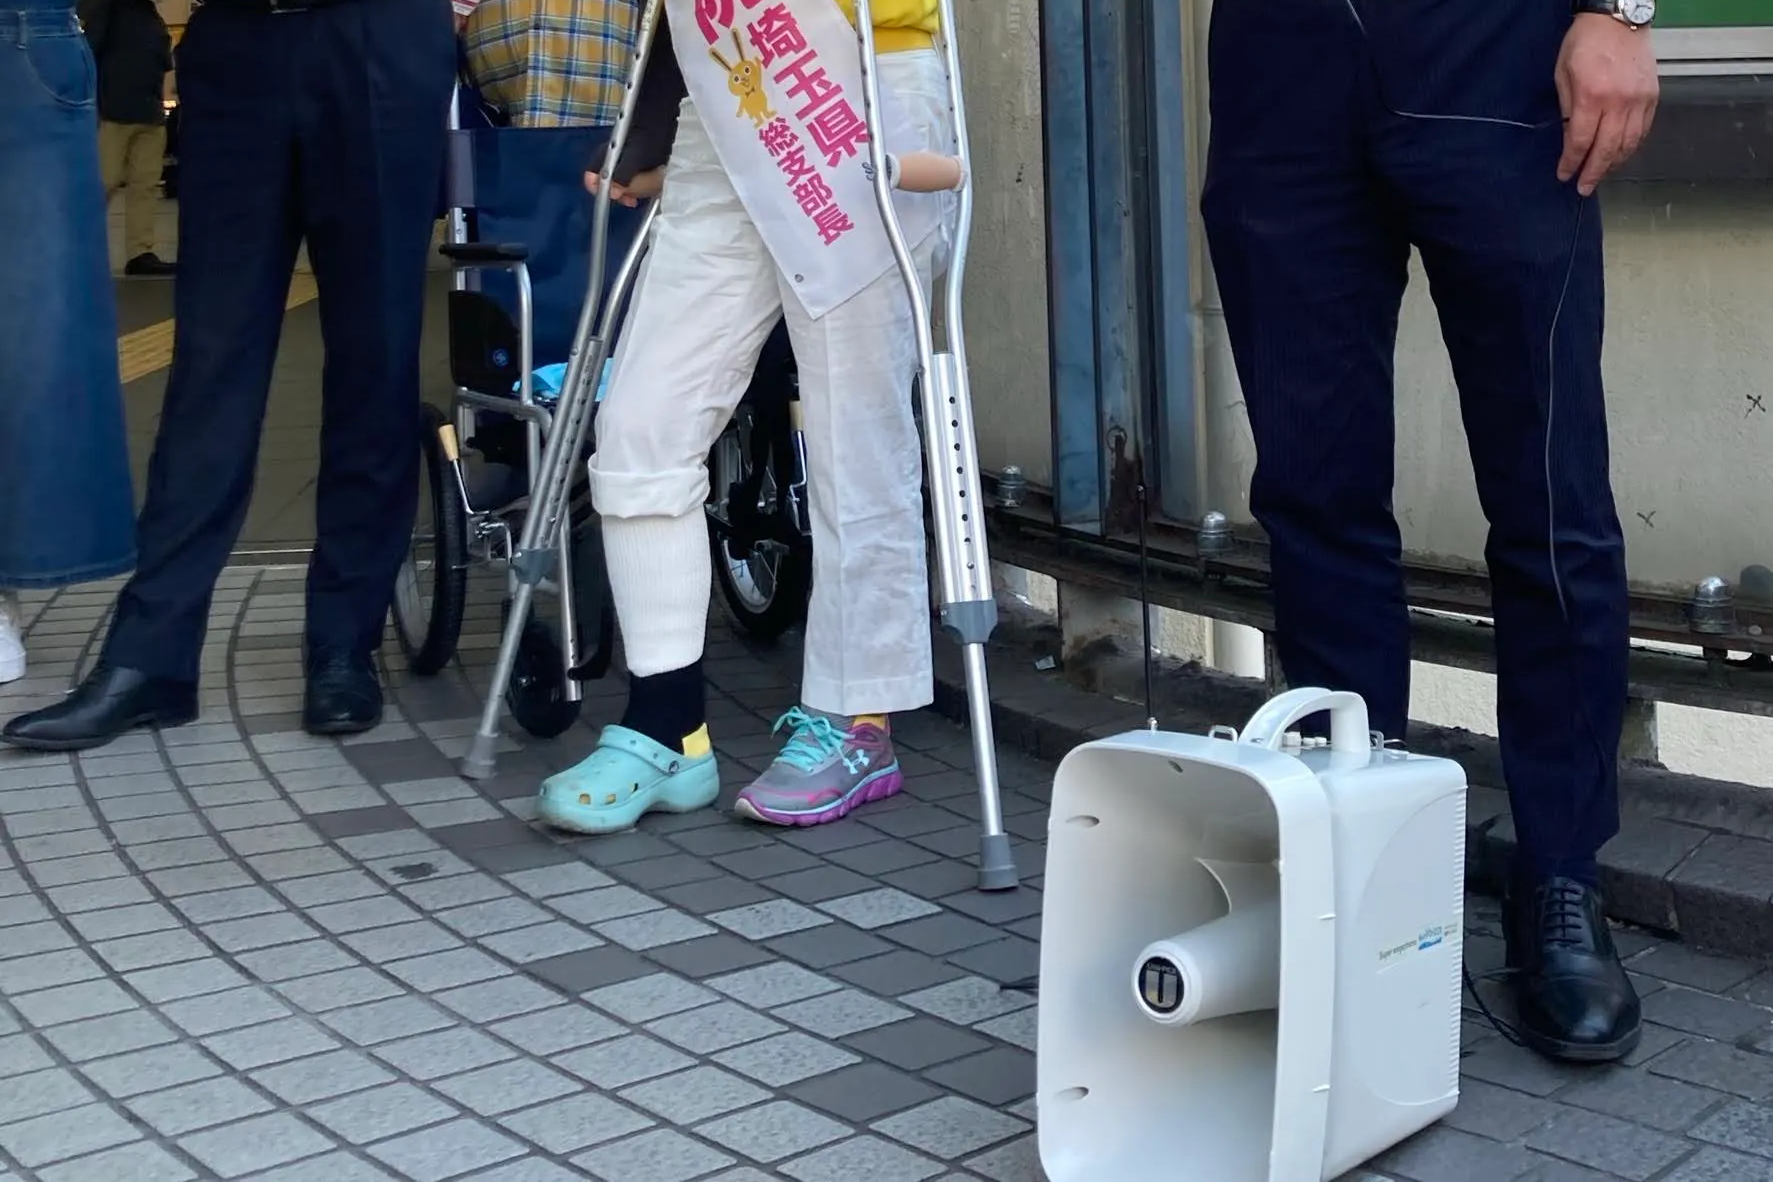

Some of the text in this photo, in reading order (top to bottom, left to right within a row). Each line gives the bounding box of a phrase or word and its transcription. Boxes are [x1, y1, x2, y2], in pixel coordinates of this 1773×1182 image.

[747, 2, 871, 168] 埼玉県
[759, 117, 855, 247] 総支部長
